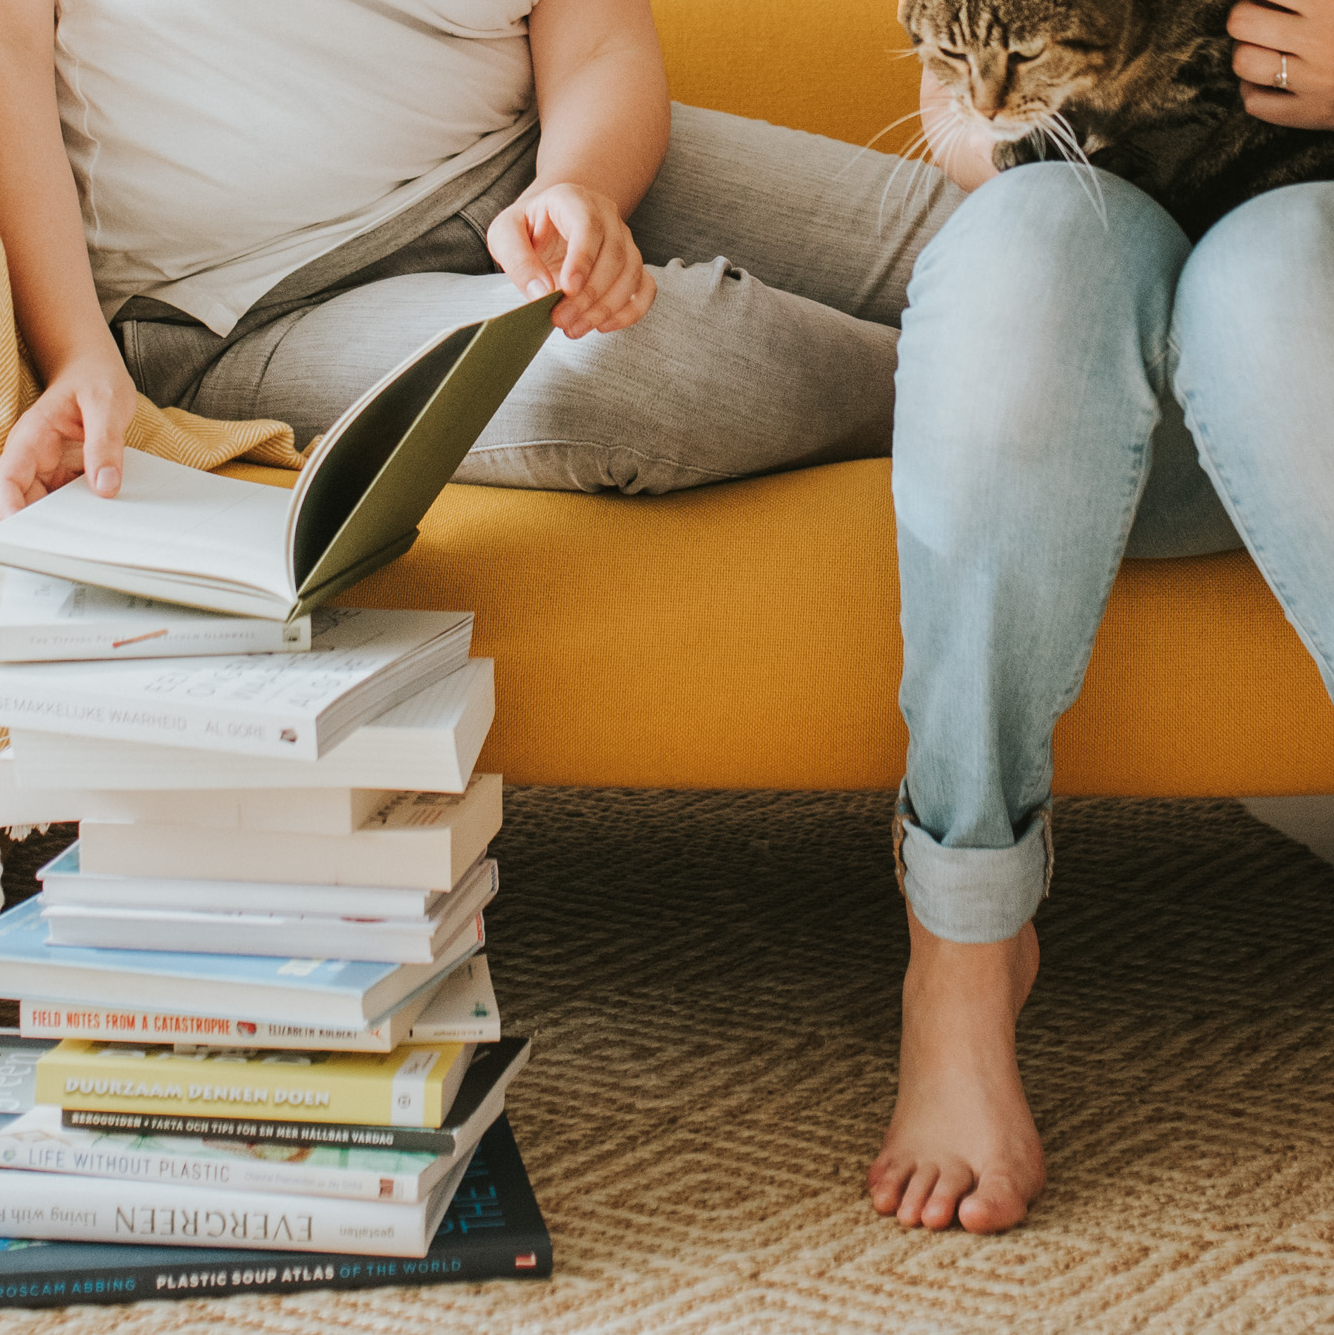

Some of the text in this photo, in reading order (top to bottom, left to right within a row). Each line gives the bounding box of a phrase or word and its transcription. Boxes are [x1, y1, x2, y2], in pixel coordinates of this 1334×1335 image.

[108, 707, 188, 731] WAARHEID
[204, 720, 266, 739] AL GORE
[31, 1009, 231, 1036] FIELD NOTES FROM A CATASTROPHE
[64, 1076, 330, 1107] DUURZAAM DENKEN DOEN
[151, 1117, 184, 1131] FAKTA
[185, 1119, 209, 1133] OCH
[211, 1121, 234, 1136] TIPS
[259, 1124, 274, 1138] EN
[276, 1125, 298, 1139] MER
[351, 1130, 394, 1146] VARDAG
[28, 1147, 231, 1183] LIFE WITHOUT PLASTIC
[11, 1206, 44, 1225] with
[51, 1206, 98, 1227] Living
[115, 1205, 314, 1242] EVERGREEN
[339, 1222, 395, 1241] gestalten
[71, 1277, 137, 1295] ABBING
[156, 1258, 463, 1291] PLASTIC SOUP ATLAS OF THE WORLD
